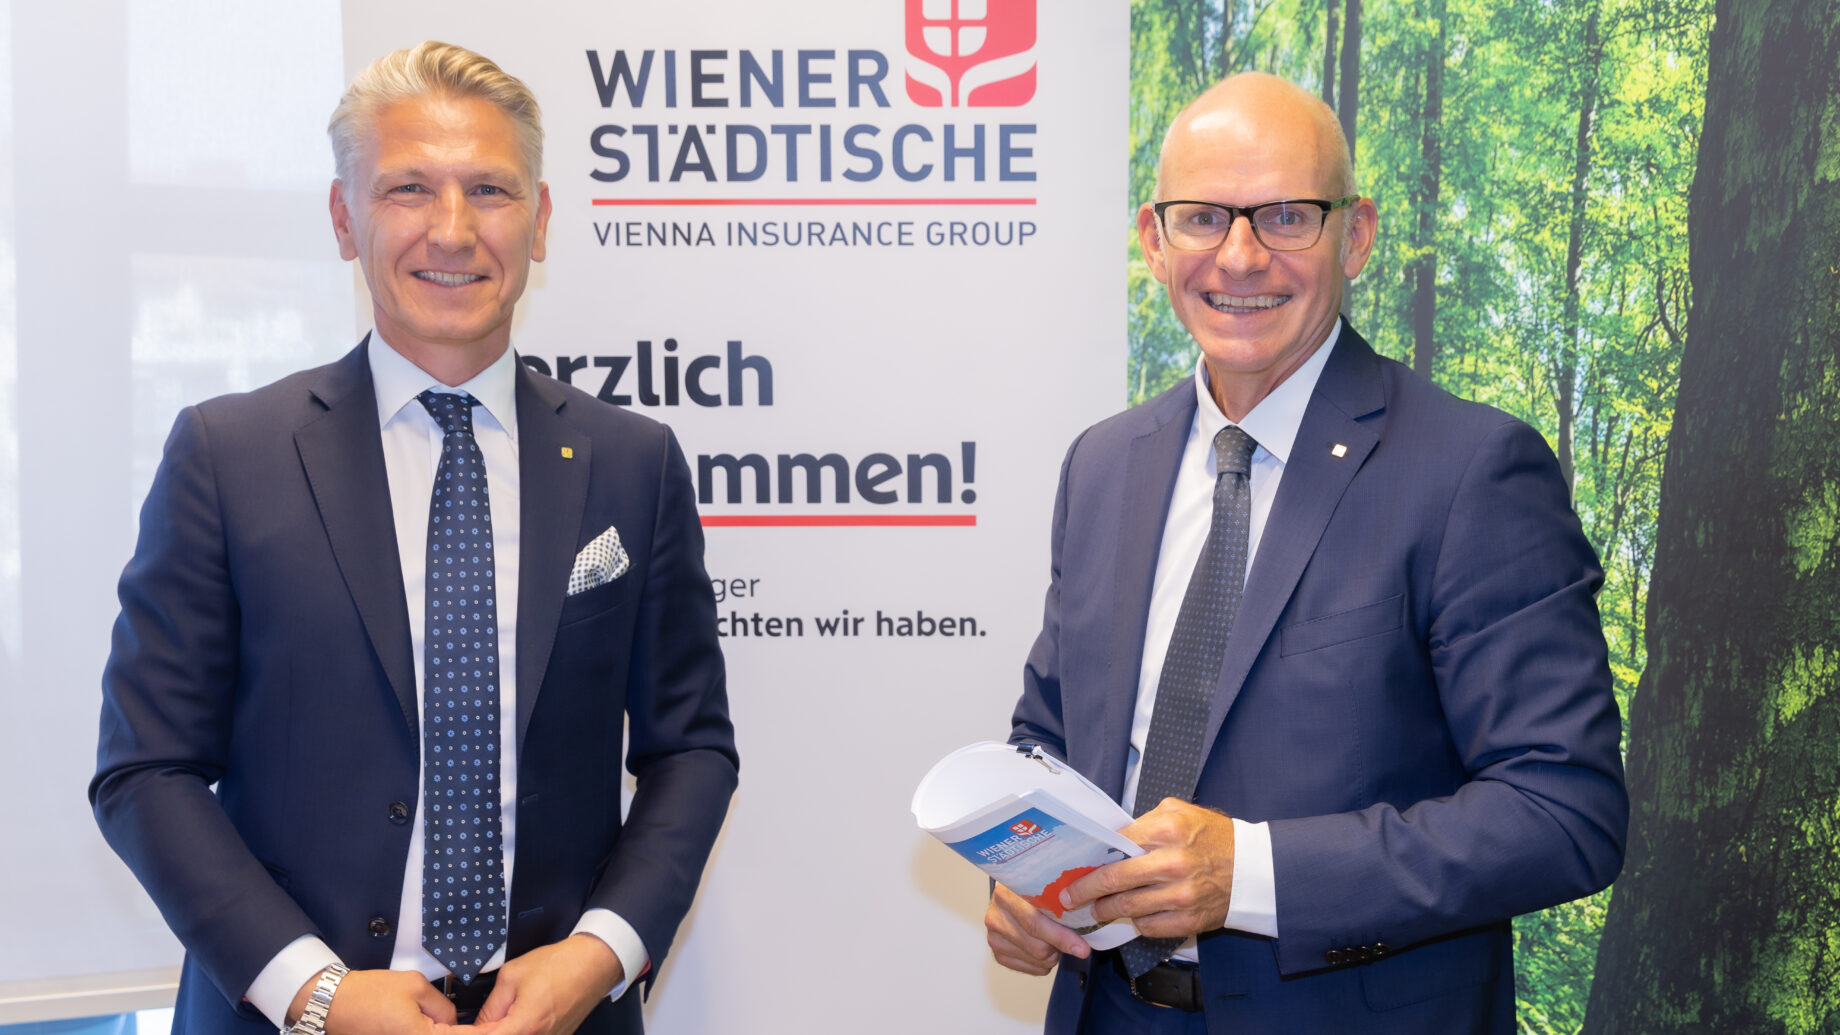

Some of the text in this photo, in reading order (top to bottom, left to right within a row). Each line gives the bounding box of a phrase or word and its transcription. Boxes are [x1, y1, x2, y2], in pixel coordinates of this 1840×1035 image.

[586, 50, 891, 108] WIENER
[589, 124, 1037, 182] STÄDTISCHE
[593, 222, 1037, 246] VIENNA INSURANCE GROUP
[814, 610, 865, 637] wir
[876, 611, 987, 637] haben.
[976, 835, 1023, 858] WIENER
